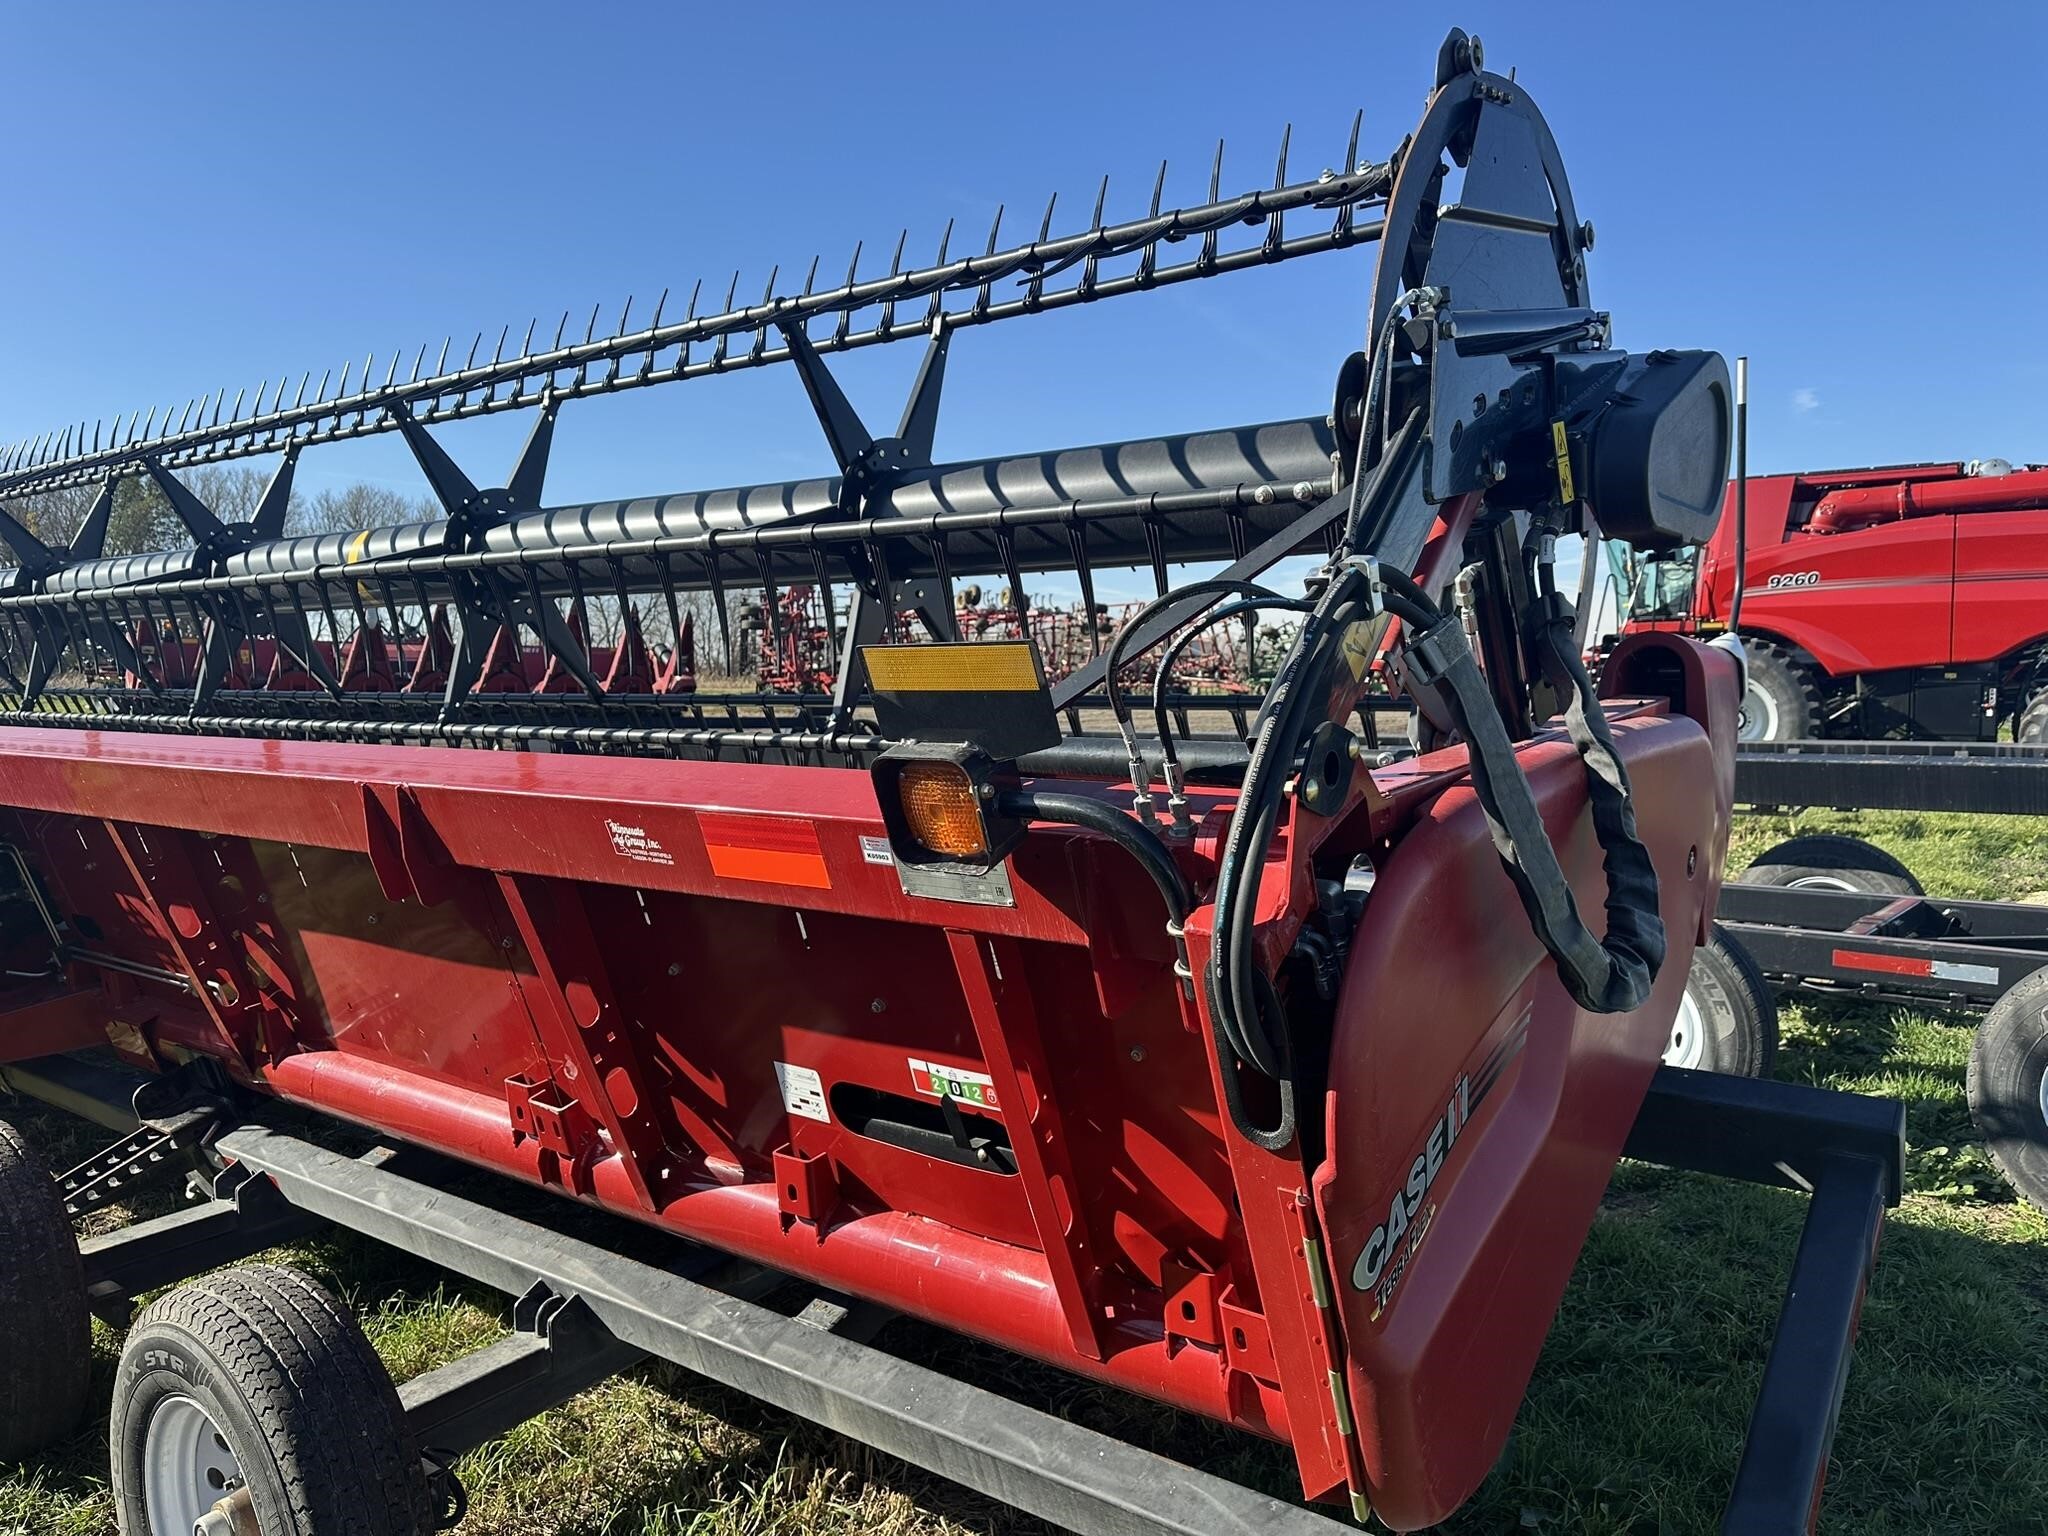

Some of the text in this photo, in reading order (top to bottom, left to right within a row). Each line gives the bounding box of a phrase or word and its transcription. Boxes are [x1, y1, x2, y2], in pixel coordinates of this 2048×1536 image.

[1769, 572, 1819, 588] 9260
[932, 1078, 982, 1099] 2 1 0 1 2
[1353, 1118, 1444, 1291] CASE
